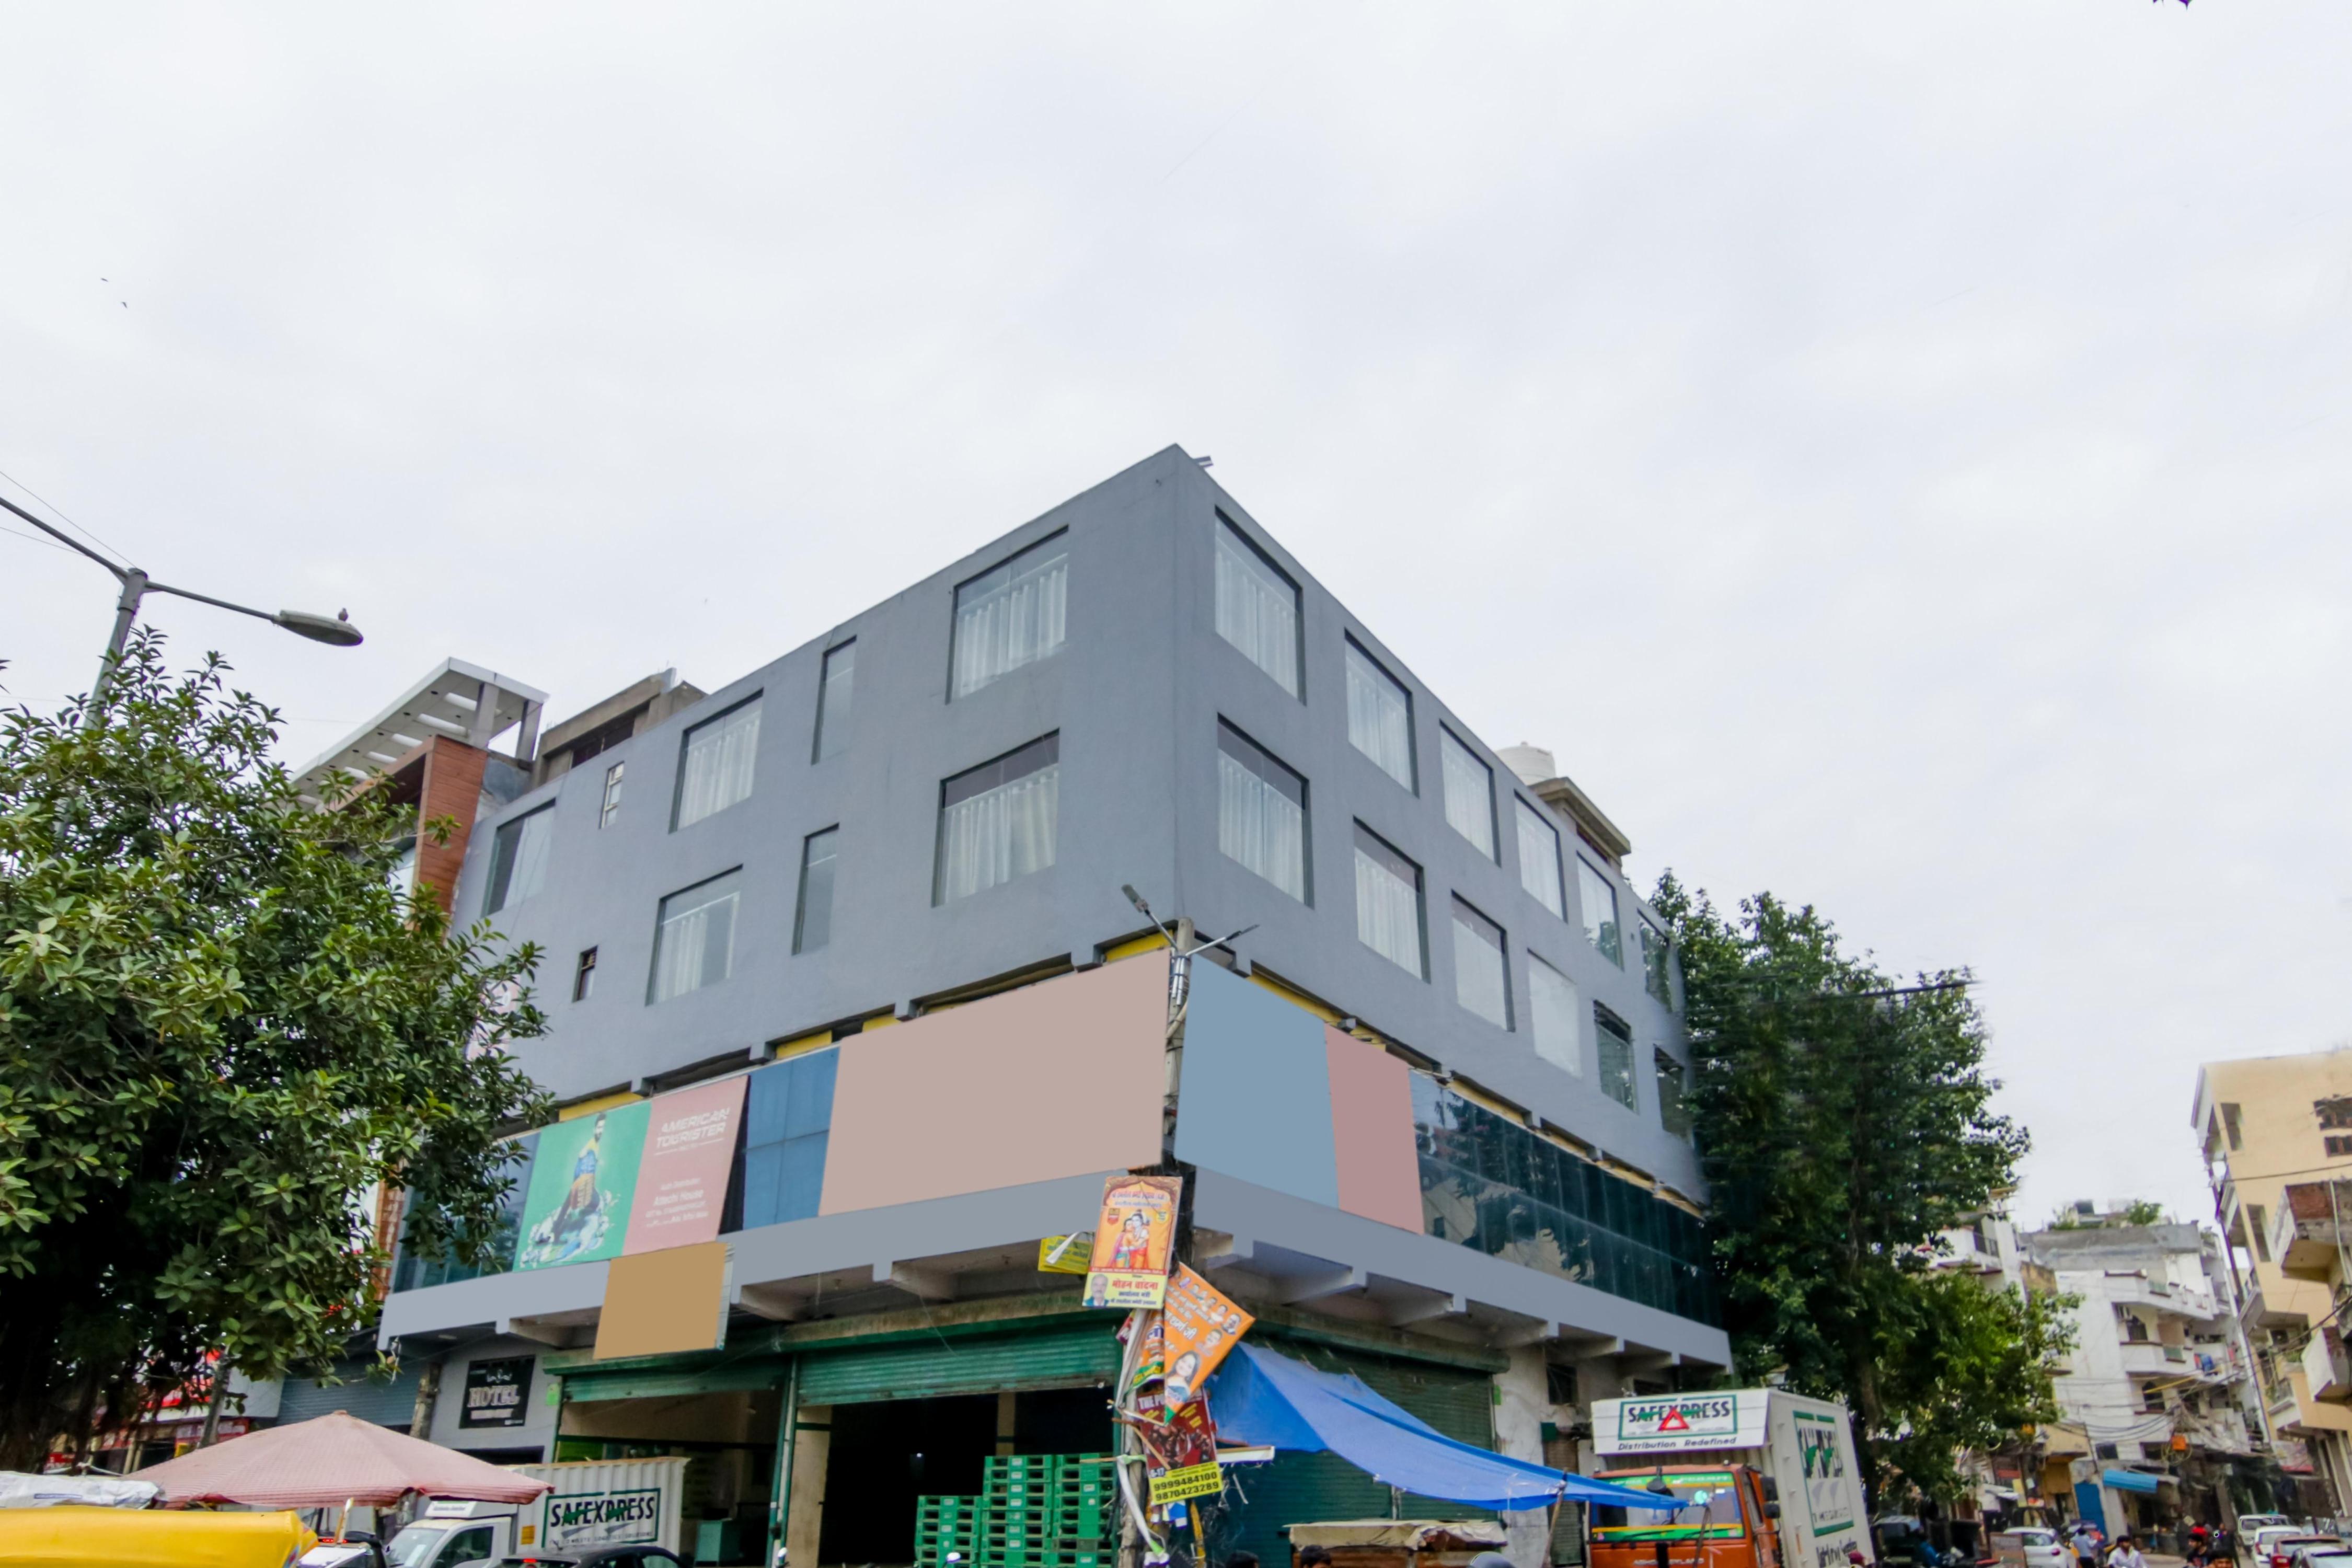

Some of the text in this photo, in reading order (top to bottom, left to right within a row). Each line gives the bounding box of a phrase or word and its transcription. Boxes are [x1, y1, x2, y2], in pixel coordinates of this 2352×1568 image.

[661, 1107, 731, 1133] AMERICAN
[656, 1122, 727, 1149] TOURISTER
[1618, 1437, 1737, 1451] Distribution Redefined
[1154, 1471, 1217, 1491] 9999484100
[1156, 1482, 1219, 1502] 9870423289
[550, 1496, 655, 1527] SAFEXPRESS
